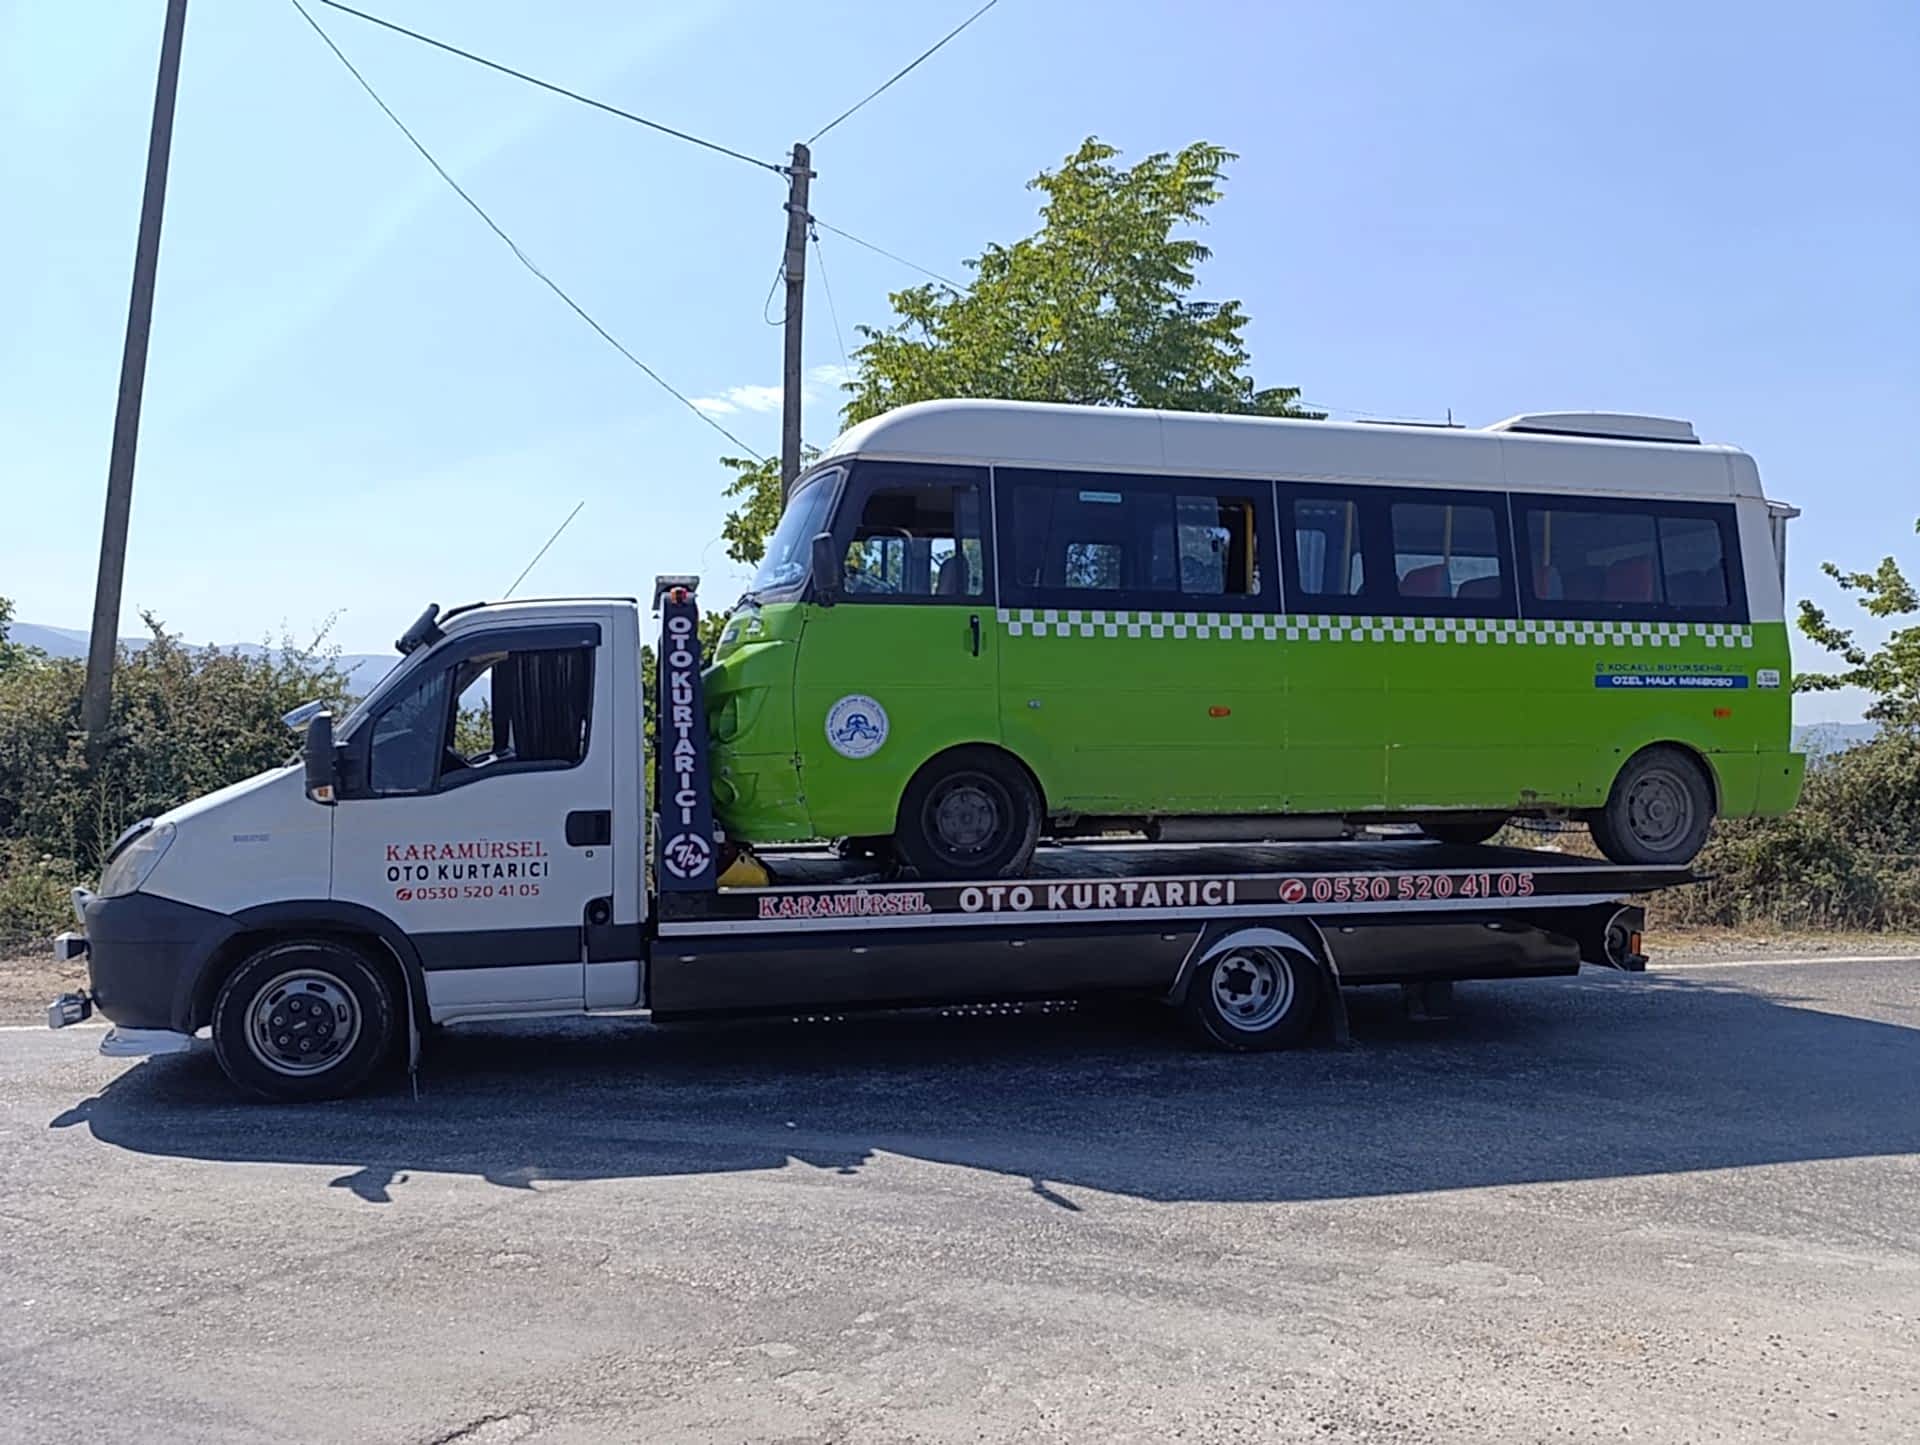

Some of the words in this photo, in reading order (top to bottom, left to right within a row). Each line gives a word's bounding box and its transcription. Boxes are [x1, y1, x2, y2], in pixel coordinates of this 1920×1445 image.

[668, 616, 693, 668] OTO
[1645, 676, 1677, 686] HALK
[672, 671, 697, 826] KURTARICI
[386, 838, 549, 861] KARAMÜRSEL
[387, 865, 429, 882] OTO
[438, 862, 548, 880] KURTARICI
[416, 887, 458, 900] 0530
[464, 885, 493, 898] 520
[498, 884, 514, 897] 41
[519, 884, 540, 897] 05
[758, 889, 931, 919] KARAMÜRSEL
[959, 885, 1033, 912] OTO
[1047, 880, 1236, 910] KURTARICI
[1311, 876, 1390, 902] 0530
[1397, 875, 1453, 900] 520
[1459, 873, 1490, 898] 41
[1497, 872, 1535, 897] 05
